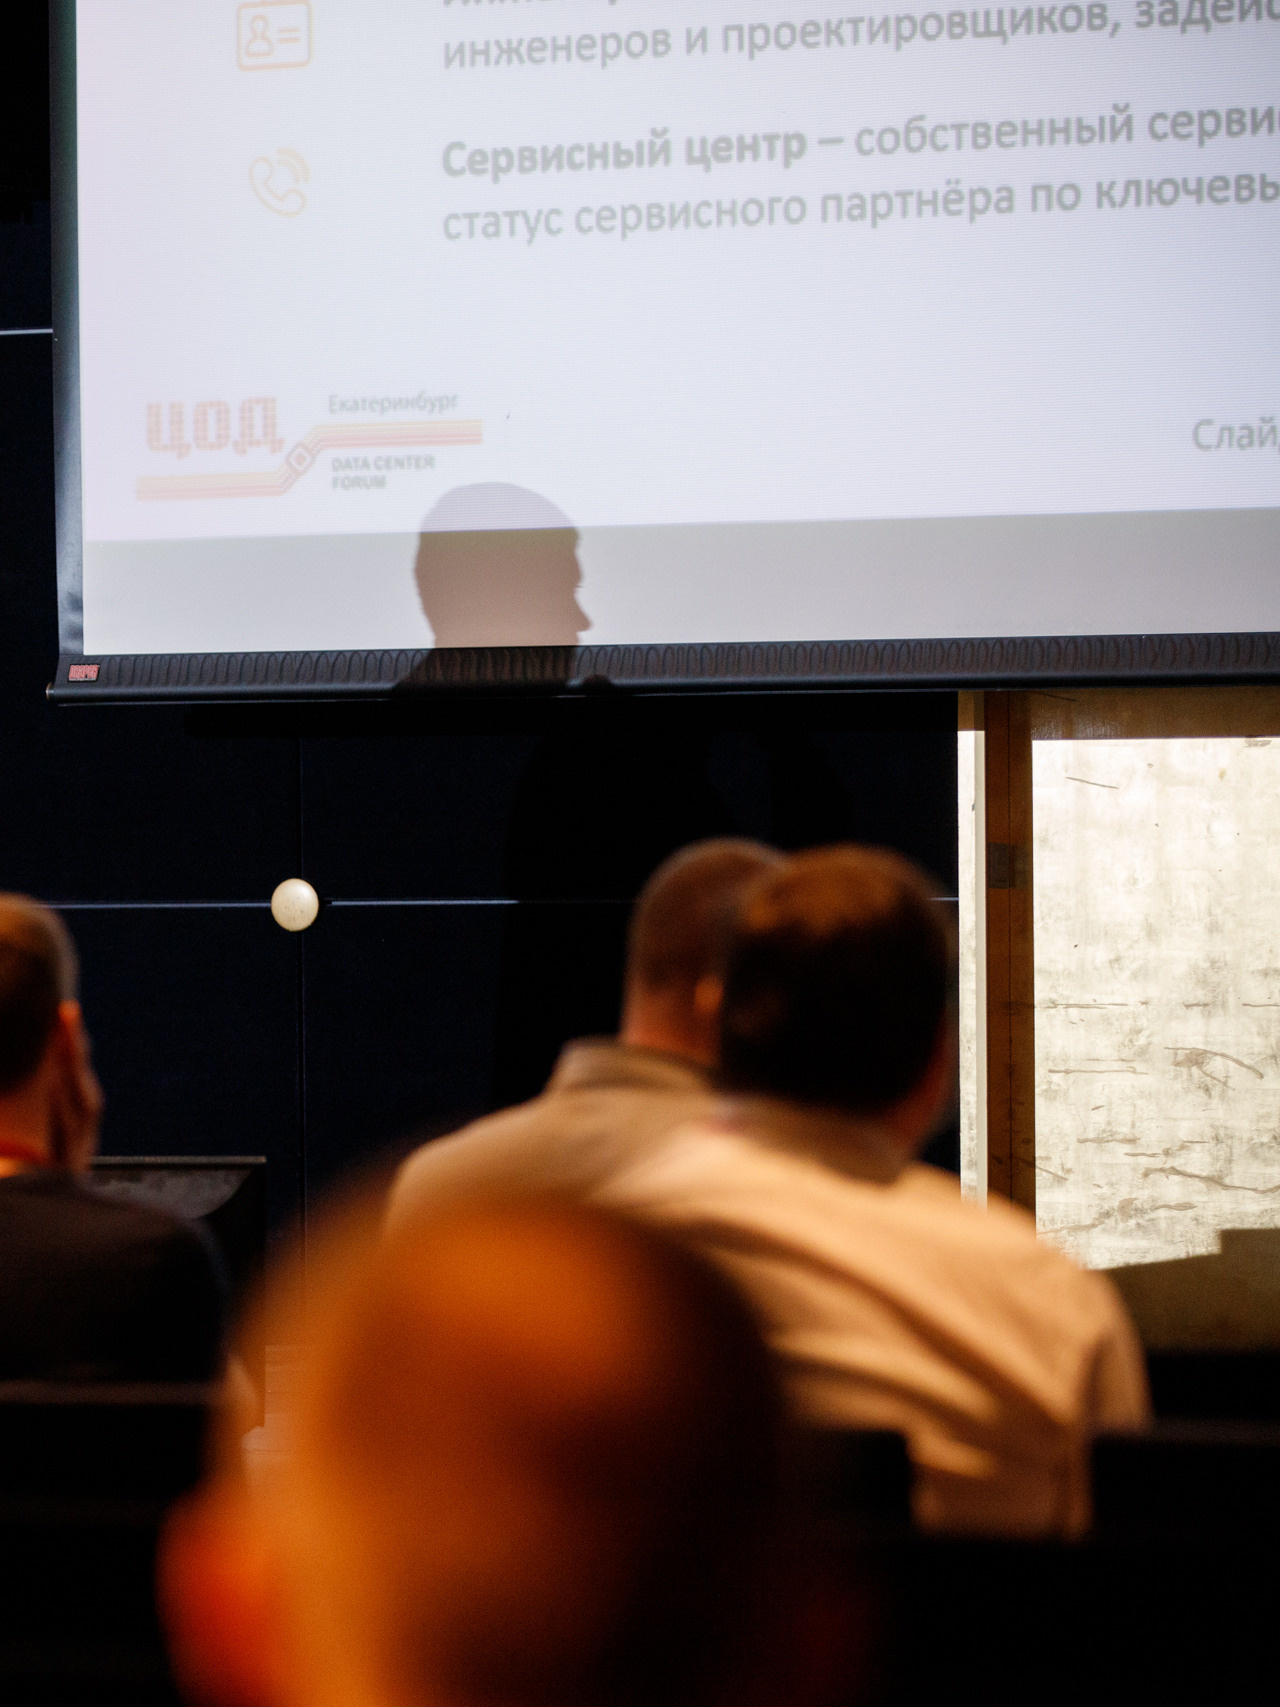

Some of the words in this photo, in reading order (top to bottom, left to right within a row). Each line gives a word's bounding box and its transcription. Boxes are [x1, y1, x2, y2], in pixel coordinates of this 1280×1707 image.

[444, 28, 672, 69] инженеров
[685, 26, 709, 55] и
[723, 2, 1122, 59] проектировщиков,
[442, 126, 673, 185] Сервисный
[685, 131, 807, 173] центр
[855, 101, 1133, 155] собственный
[1148, 104, 1280, 148] серви
[443, 207, 564, 246] статус
[574, 196, 807, 241] сервисного
[820, 177, 1017, 229] партнёра
[1030, 182, 1083, 213] по
[146, 396, 286, 461] ЦОД
[328, 390, 459, 416] Екатеринбург
[1193, 416, 1280, 453] Слай
[332, 456, 370, 472] DATA
[374, 454, 435, 471] CENTER
[332, 475, 387, 490] FORUM
